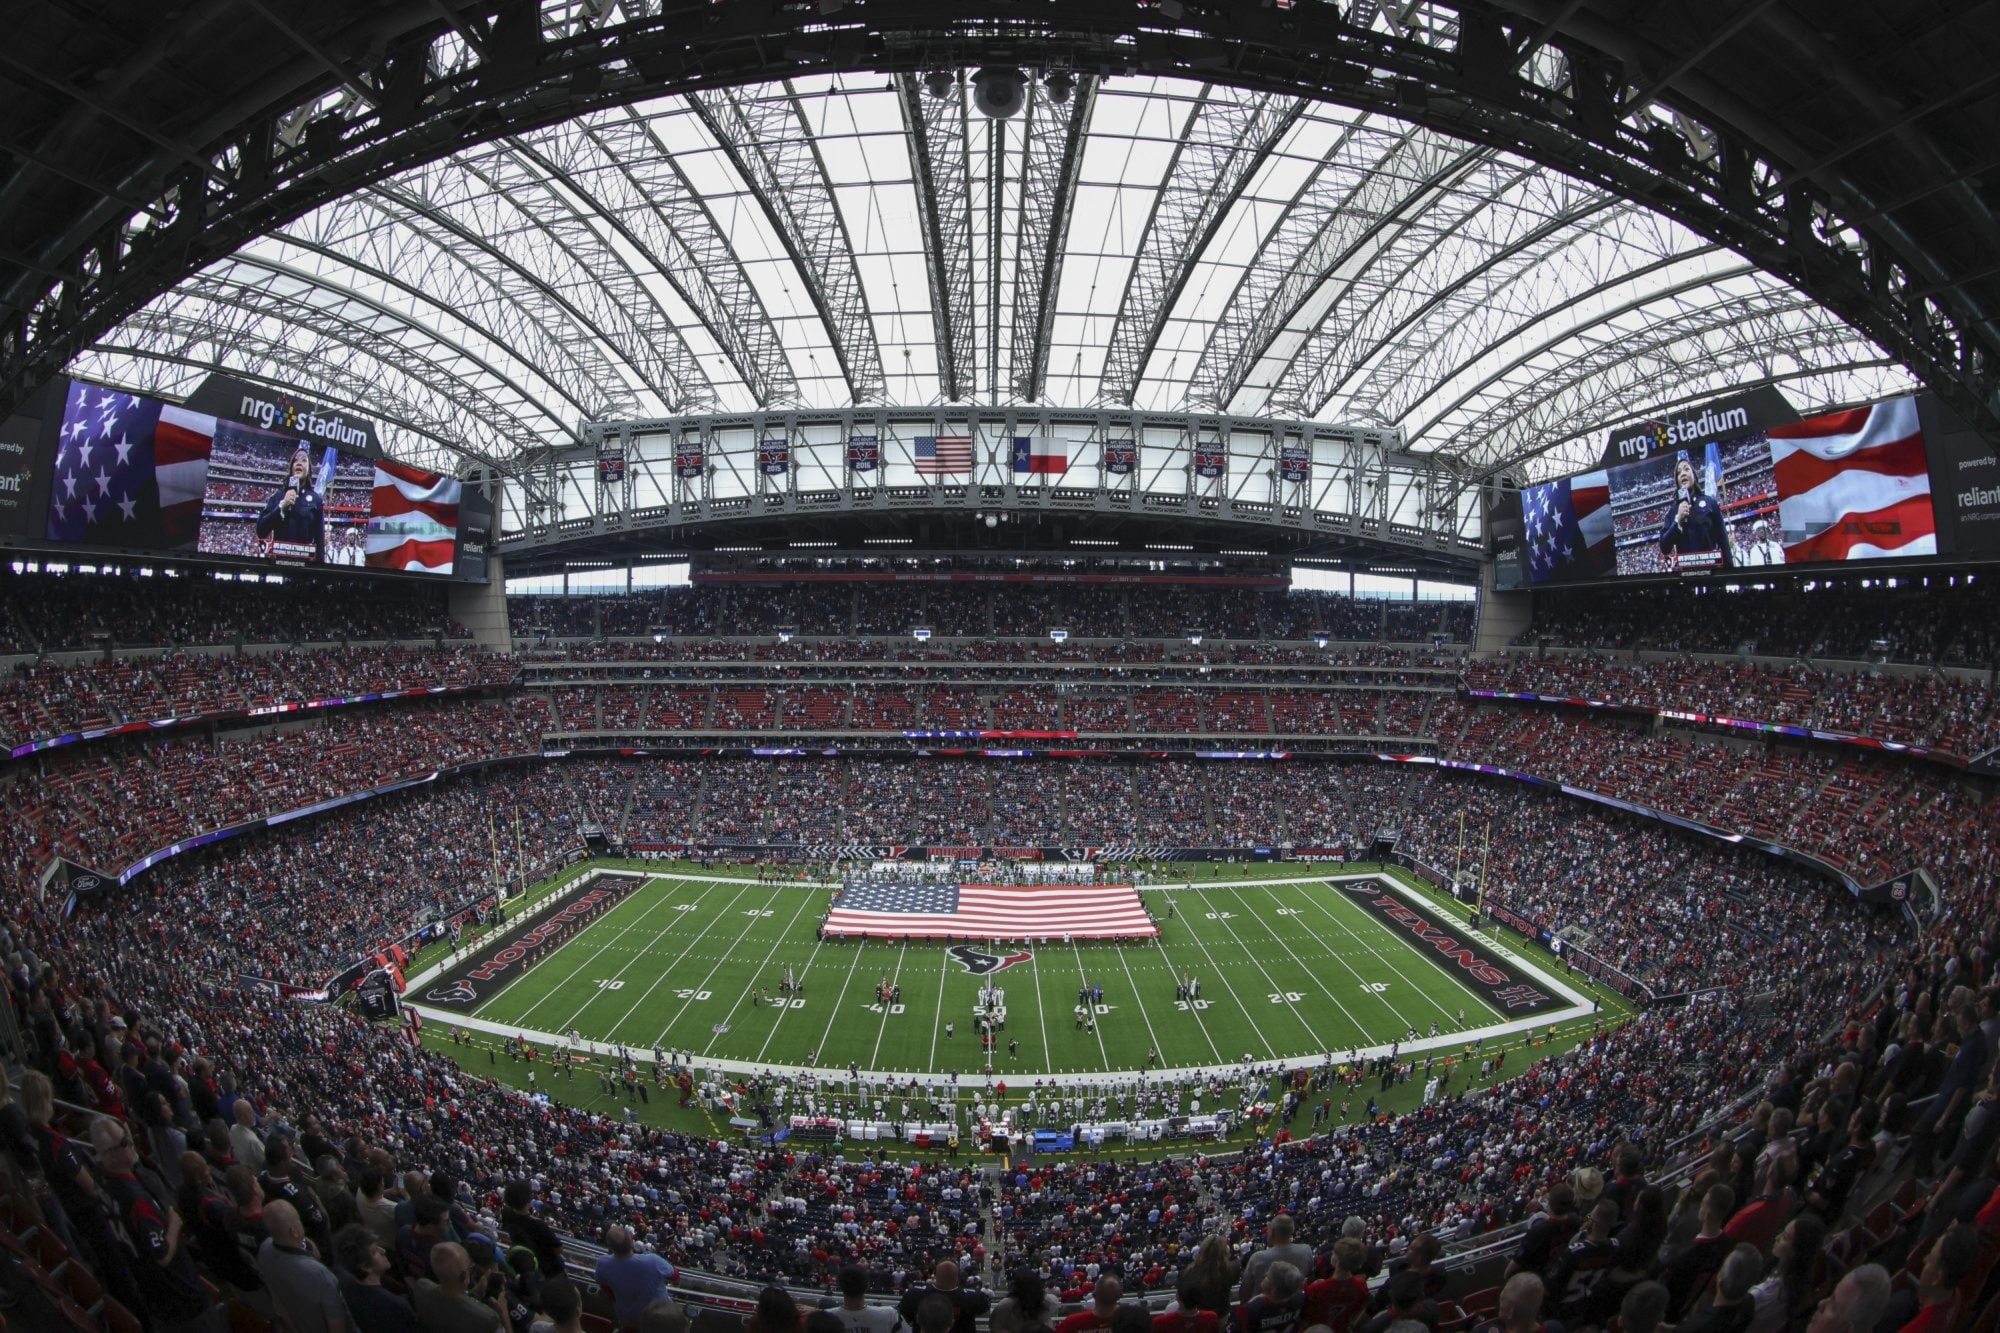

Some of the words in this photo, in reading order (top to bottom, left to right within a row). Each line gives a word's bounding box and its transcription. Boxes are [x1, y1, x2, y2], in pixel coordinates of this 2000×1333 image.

[240, 396, 275, 429] nrg
[296, 413, 367, 448] stadium
[1619, 435, 1648, 459] nrg
[1667, 407, 1747, 445] stadium
[1959, 457, 1987, 470] powered
[1988, 456, 1996, 466] by
[464, 543, 483, 554] reliant
[1497, 550, 1517, 561] reliant
[466, 890, 612, 981] HOUSTON
[1428, 905, 1462, 924] SALUTE
[1472, 933, 1515, 958] SERVICE
[1372, 895, 1510, 985] TEXANS
[597, 979, 626, 990] 10
[1360, 982, 1387, 994] 10
[677, 989, 712, 1000] 20
[1268, 991, 1302, 1004] 20
[772, 997, 806, 1008] 30
[869, 1003, 905, 1014] 40
[1174, 1000, 1209, 1010] 30
[973, 1006, 1007, 1016] 50
[1074, 1004, 1109, 1015] 40
[283, 1182, 298, 1195] 12
[511, 1304, 526, 1320] 98
